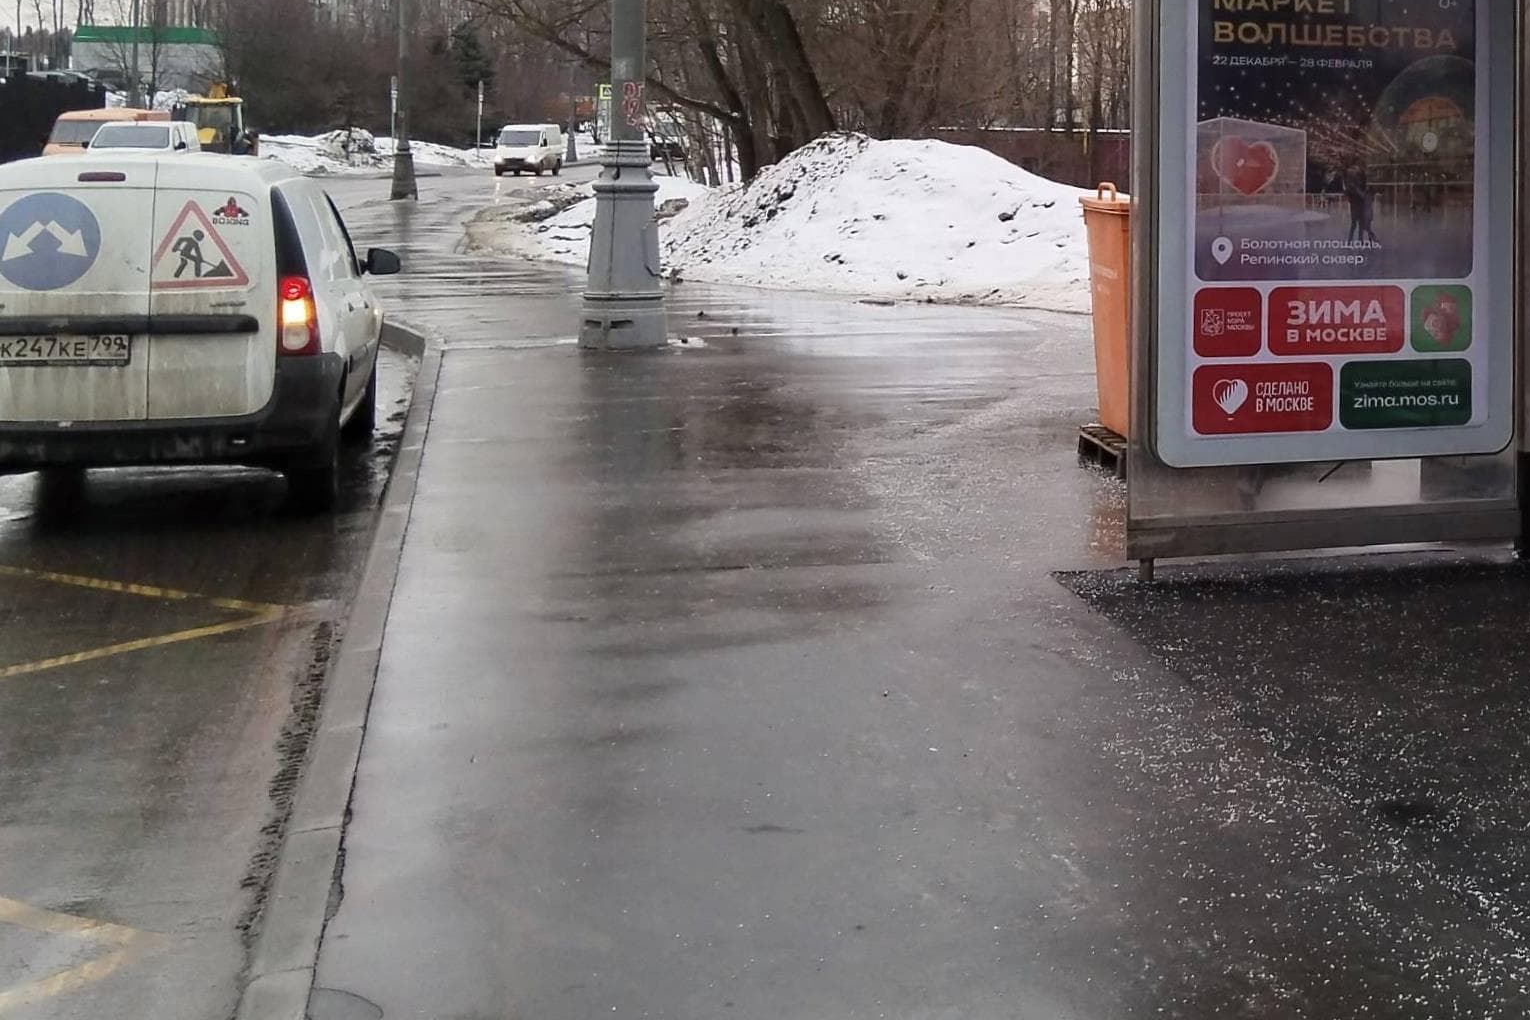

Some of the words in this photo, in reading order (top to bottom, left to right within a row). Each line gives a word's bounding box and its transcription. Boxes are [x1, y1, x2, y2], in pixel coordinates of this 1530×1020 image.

[1213, 21, 1457, 50] ВОЛШЕБСТВА
[1212, 55, 1228, 66] 22
[1229, 56, 1286, 67] ДЕКАБРЯ
[1317, 58, 1374, 69] ФЕВРАЛЯ
[1240, 237, 1311, 250] Болотная
[1240, 253, 1320, 265] Репинский
[1322, 254, 1364, 266] сквер
[1286, 299, 1387, 326] ЗИМА
[1286, 330, 1300, 343] В
[1305, 327, 1387, 342] МОСКВЕ
[1256, 381, 1310, 398] СДЕЛАНО
[1256, 398, 1264, 413] В
[1265, 397, 1315, 413] МОСКВЕ
[1353, 394, 1460, 409] zima.mos.ru
